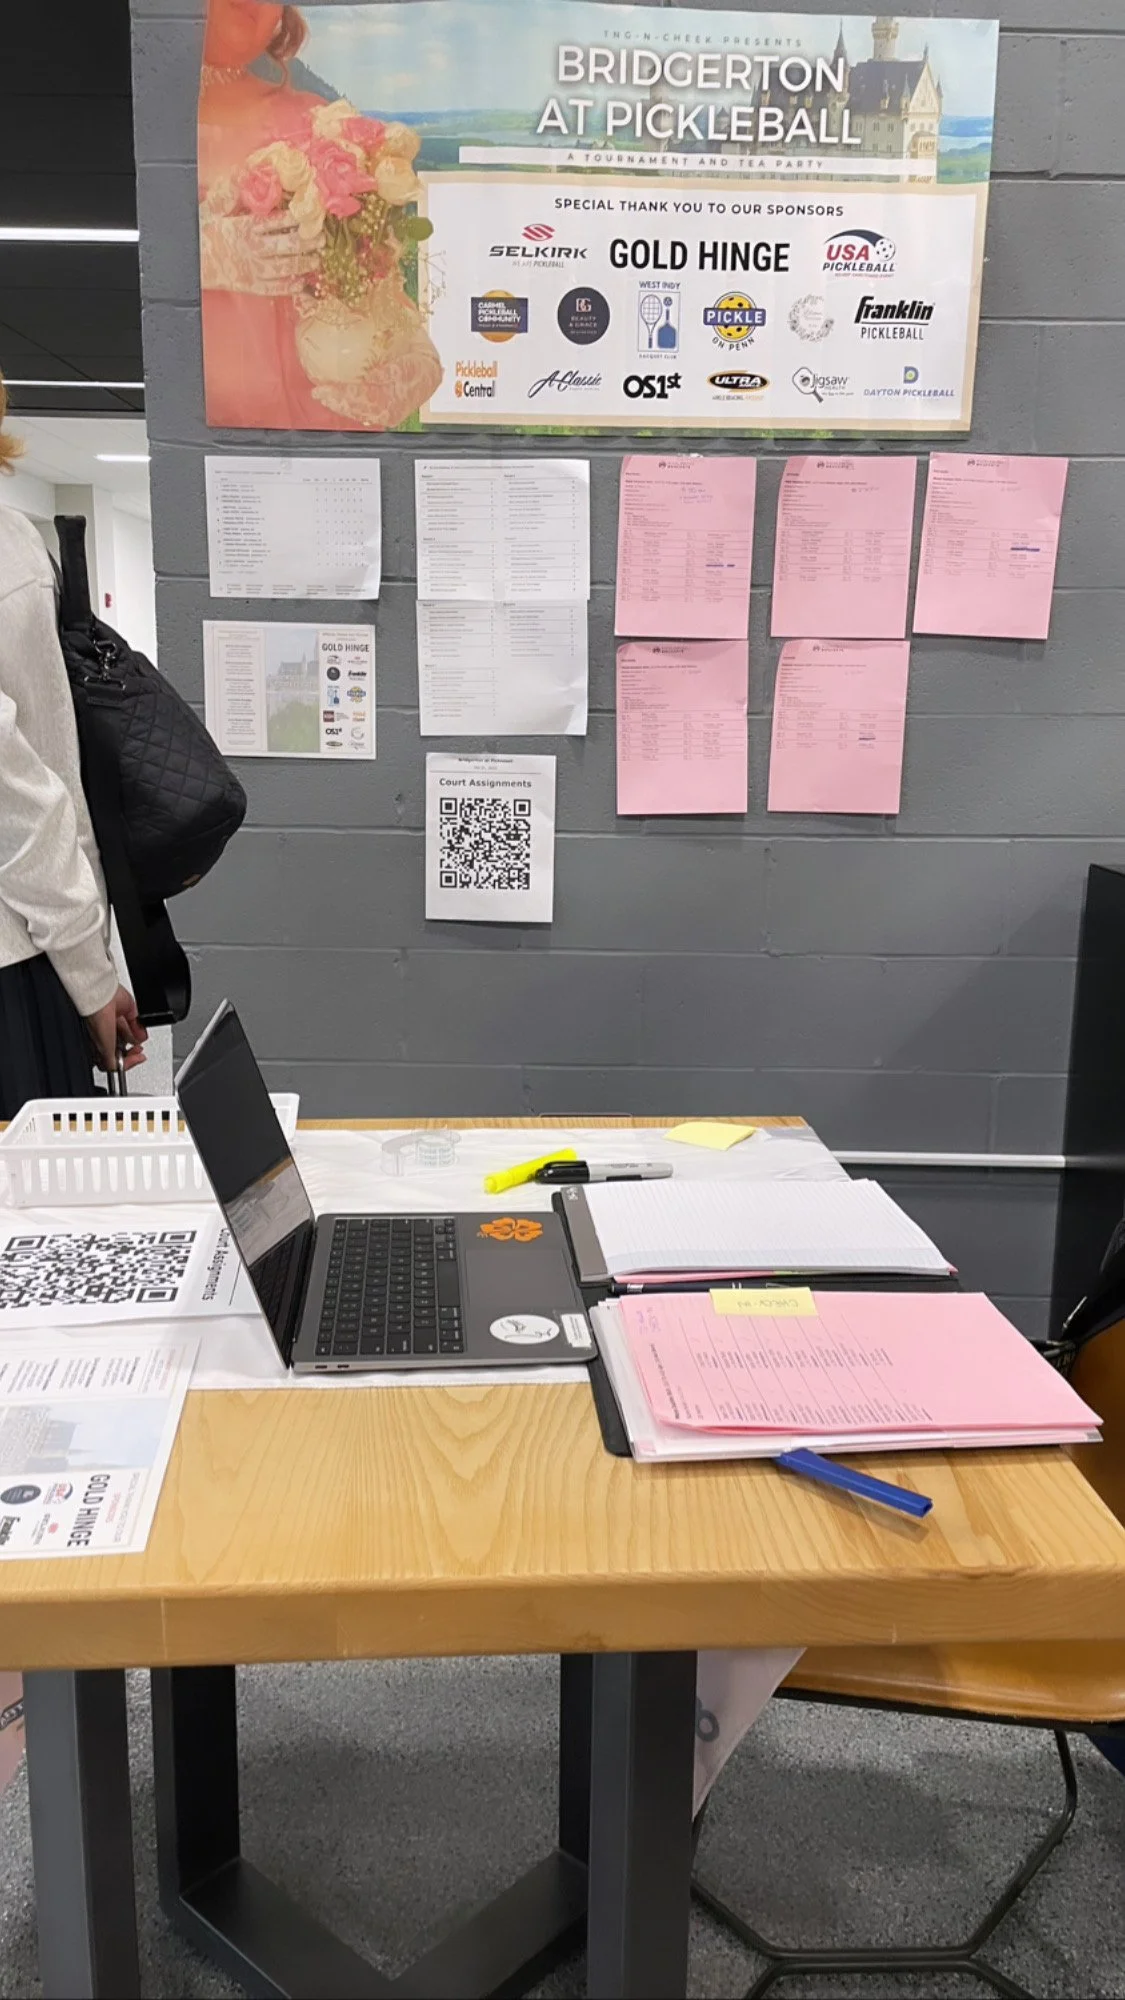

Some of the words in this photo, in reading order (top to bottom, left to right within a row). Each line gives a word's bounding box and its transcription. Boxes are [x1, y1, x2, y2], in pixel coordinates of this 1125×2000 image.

[723, 36, 803, 48] PRESENTS
[557, 44, 844, 93] BRIDGERTON
[536, 98, 593, 137] AT
[605, 101, 862, 145] PICKLEBALL
[567, 153, 575, 161] A
[584, 153, 689, 166] TOURNAMENT
[699, 157, 729, 167] AND
[739, 158, 766, 168] TEA
[776, 160, 825, 170] PARTY
[555, 198, 614, 210] SPECIAL
[620, 200, 668, 212] THANK
[673, 202, 702, 213] YOU
[708, 203, 726, 214] TO
[731, 203, 762, 215] OUR
[767, 204, 844, 217] SPONSORS
[489, 245, 588, 260] SELKIRK
[610, 238, 688, 270] GOLD
[698, 240, 790, 273] HINGE
[826, 244, 869, 261] USA
[822, 261, 895, 273] PICKLEBALL
[639, 281, 660, 289] WEST
[662, 281, 681, 290] INDY
[478, 301, 506, 309] CARMEL
[478, 315, 521, 323] COMMUNITY
[706, 309, 764, 325] PICKLE
[861, 327, 924, 341] PICKLEBALL
[712, 336, 726, 350] ON
[729, 337, 755, 351] PENN
[455, 361, 498, 378] Pickleball
[622, 372, 682, 400] OS1st
[714, 376, 762, 387] ULTRA
[811, 373, 848, 389] Jigsaw
[463, 381, 496, 398] Central
[864, 388, 900, 397] DAYTON
[903, 388, 956, 398] PICKLEBALL
[322, 642, 343, 652] GOLD
[345, 643, 370, 652] HINGE
[439, 777, 466, 787] Court
[469, 778, 532, 789] Assignments
[216, 1228, 231, 1248] Court
[202, 1250, 229, 1301] Assignments
[83, 1474, 111, 1505] GOLD
[67, 1507, 101, 1548] HINGE
